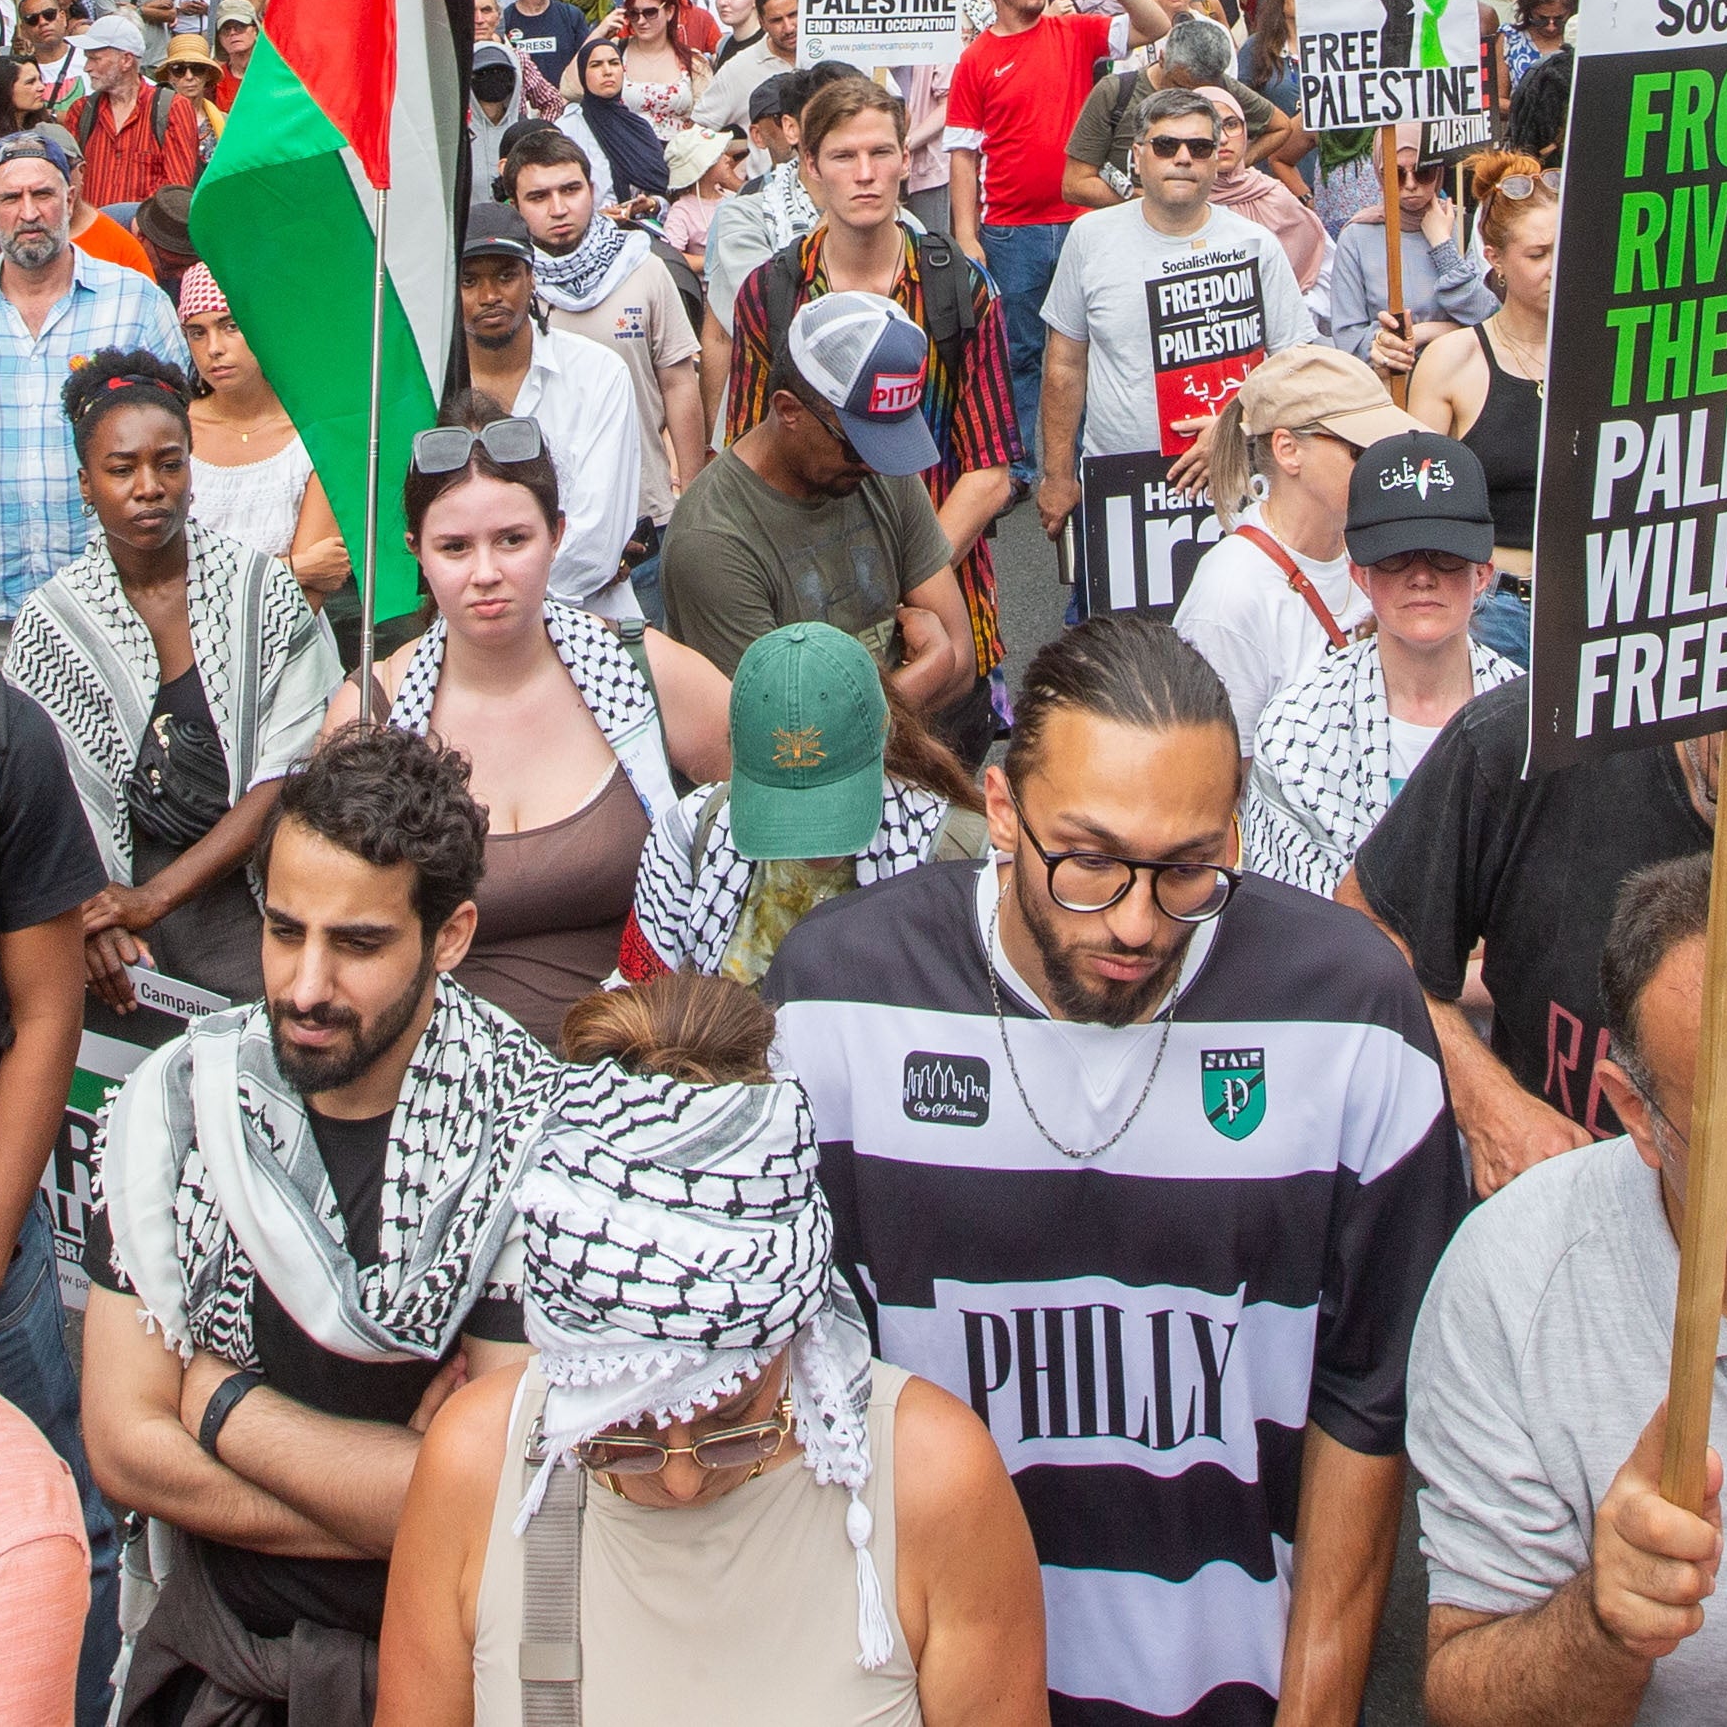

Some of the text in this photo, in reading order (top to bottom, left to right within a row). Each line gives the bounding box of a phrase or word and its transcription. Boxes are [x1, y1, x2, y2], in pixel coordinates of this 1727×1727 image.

[807, 17, 954, 34] END ISRAELI OCCUPATION
[518, 40, 553, 51] PRESS
[830, 41, 933, 52] www.palestinecampaign.org
[1299, 30, 1378, 73] FREE
[1302, 66, 1482, 128] PALESTINE
[1429, 111, 1492, 154] PALESTINE
[1162, 249, 1247, 273] Socialist Worker
[1158, 267, 1254, 317] FREEDOM
[1204, 308, 1220, 324] for
[1158, 312, 1261, 366] PALESTINE
[1144, 481, 1215, 512] Han
[140, 983, 222, 1015] Campaig
[1205, 1053, 1262, 1068] STATE
[959, 1303, 1239, 1451] PHILLY
